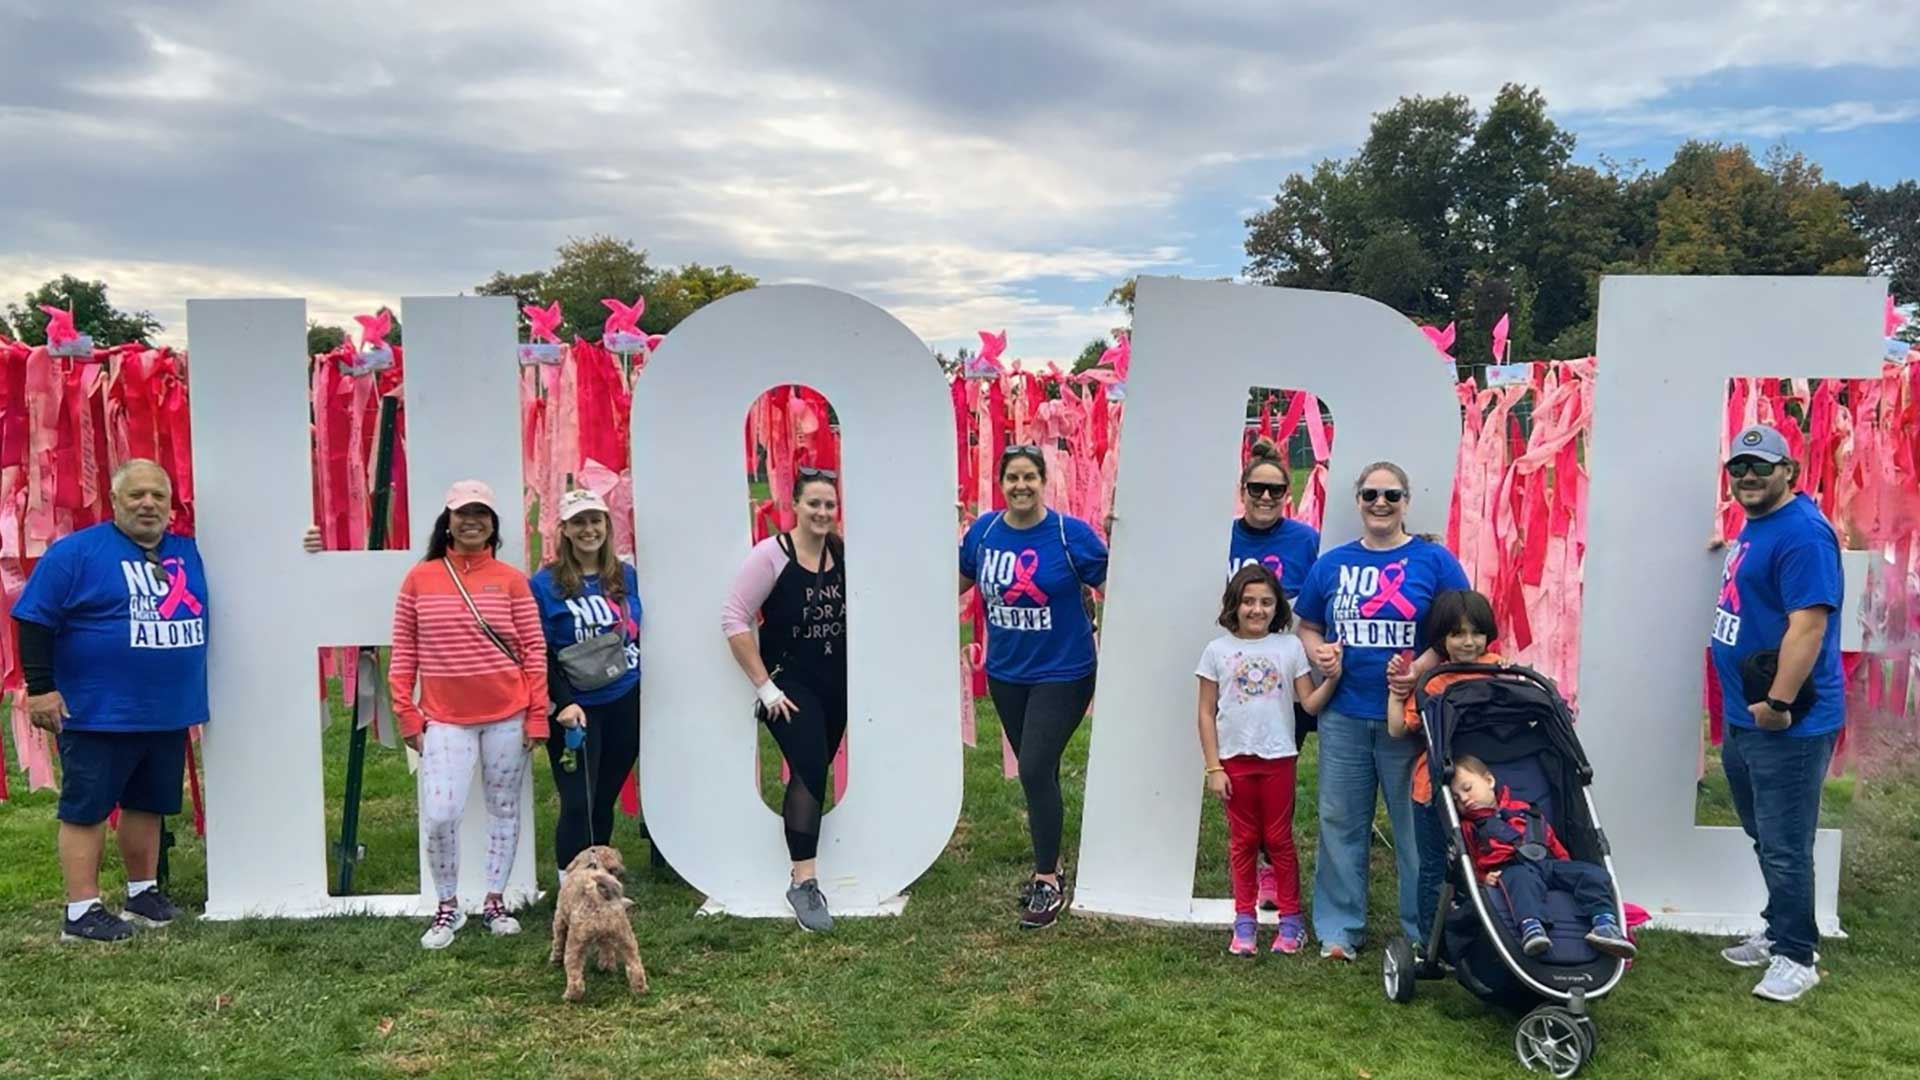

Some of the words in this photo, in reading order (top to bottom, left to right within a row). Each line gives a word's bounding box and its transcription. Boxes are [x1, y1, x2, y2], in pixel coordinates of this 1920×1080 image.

[121, 560, 170, 596] NO
[983, 548, 1016, 586] NO
[1337, 564, 1379, 596] NO
[187, 274, 1889, 940] HOPE
[806, 585, 842, 601] PNK
[1333, 594, 1361, 611] ONE
[565, 594, 613, 627] NO
[135, 620, 202, 646] ALONE
